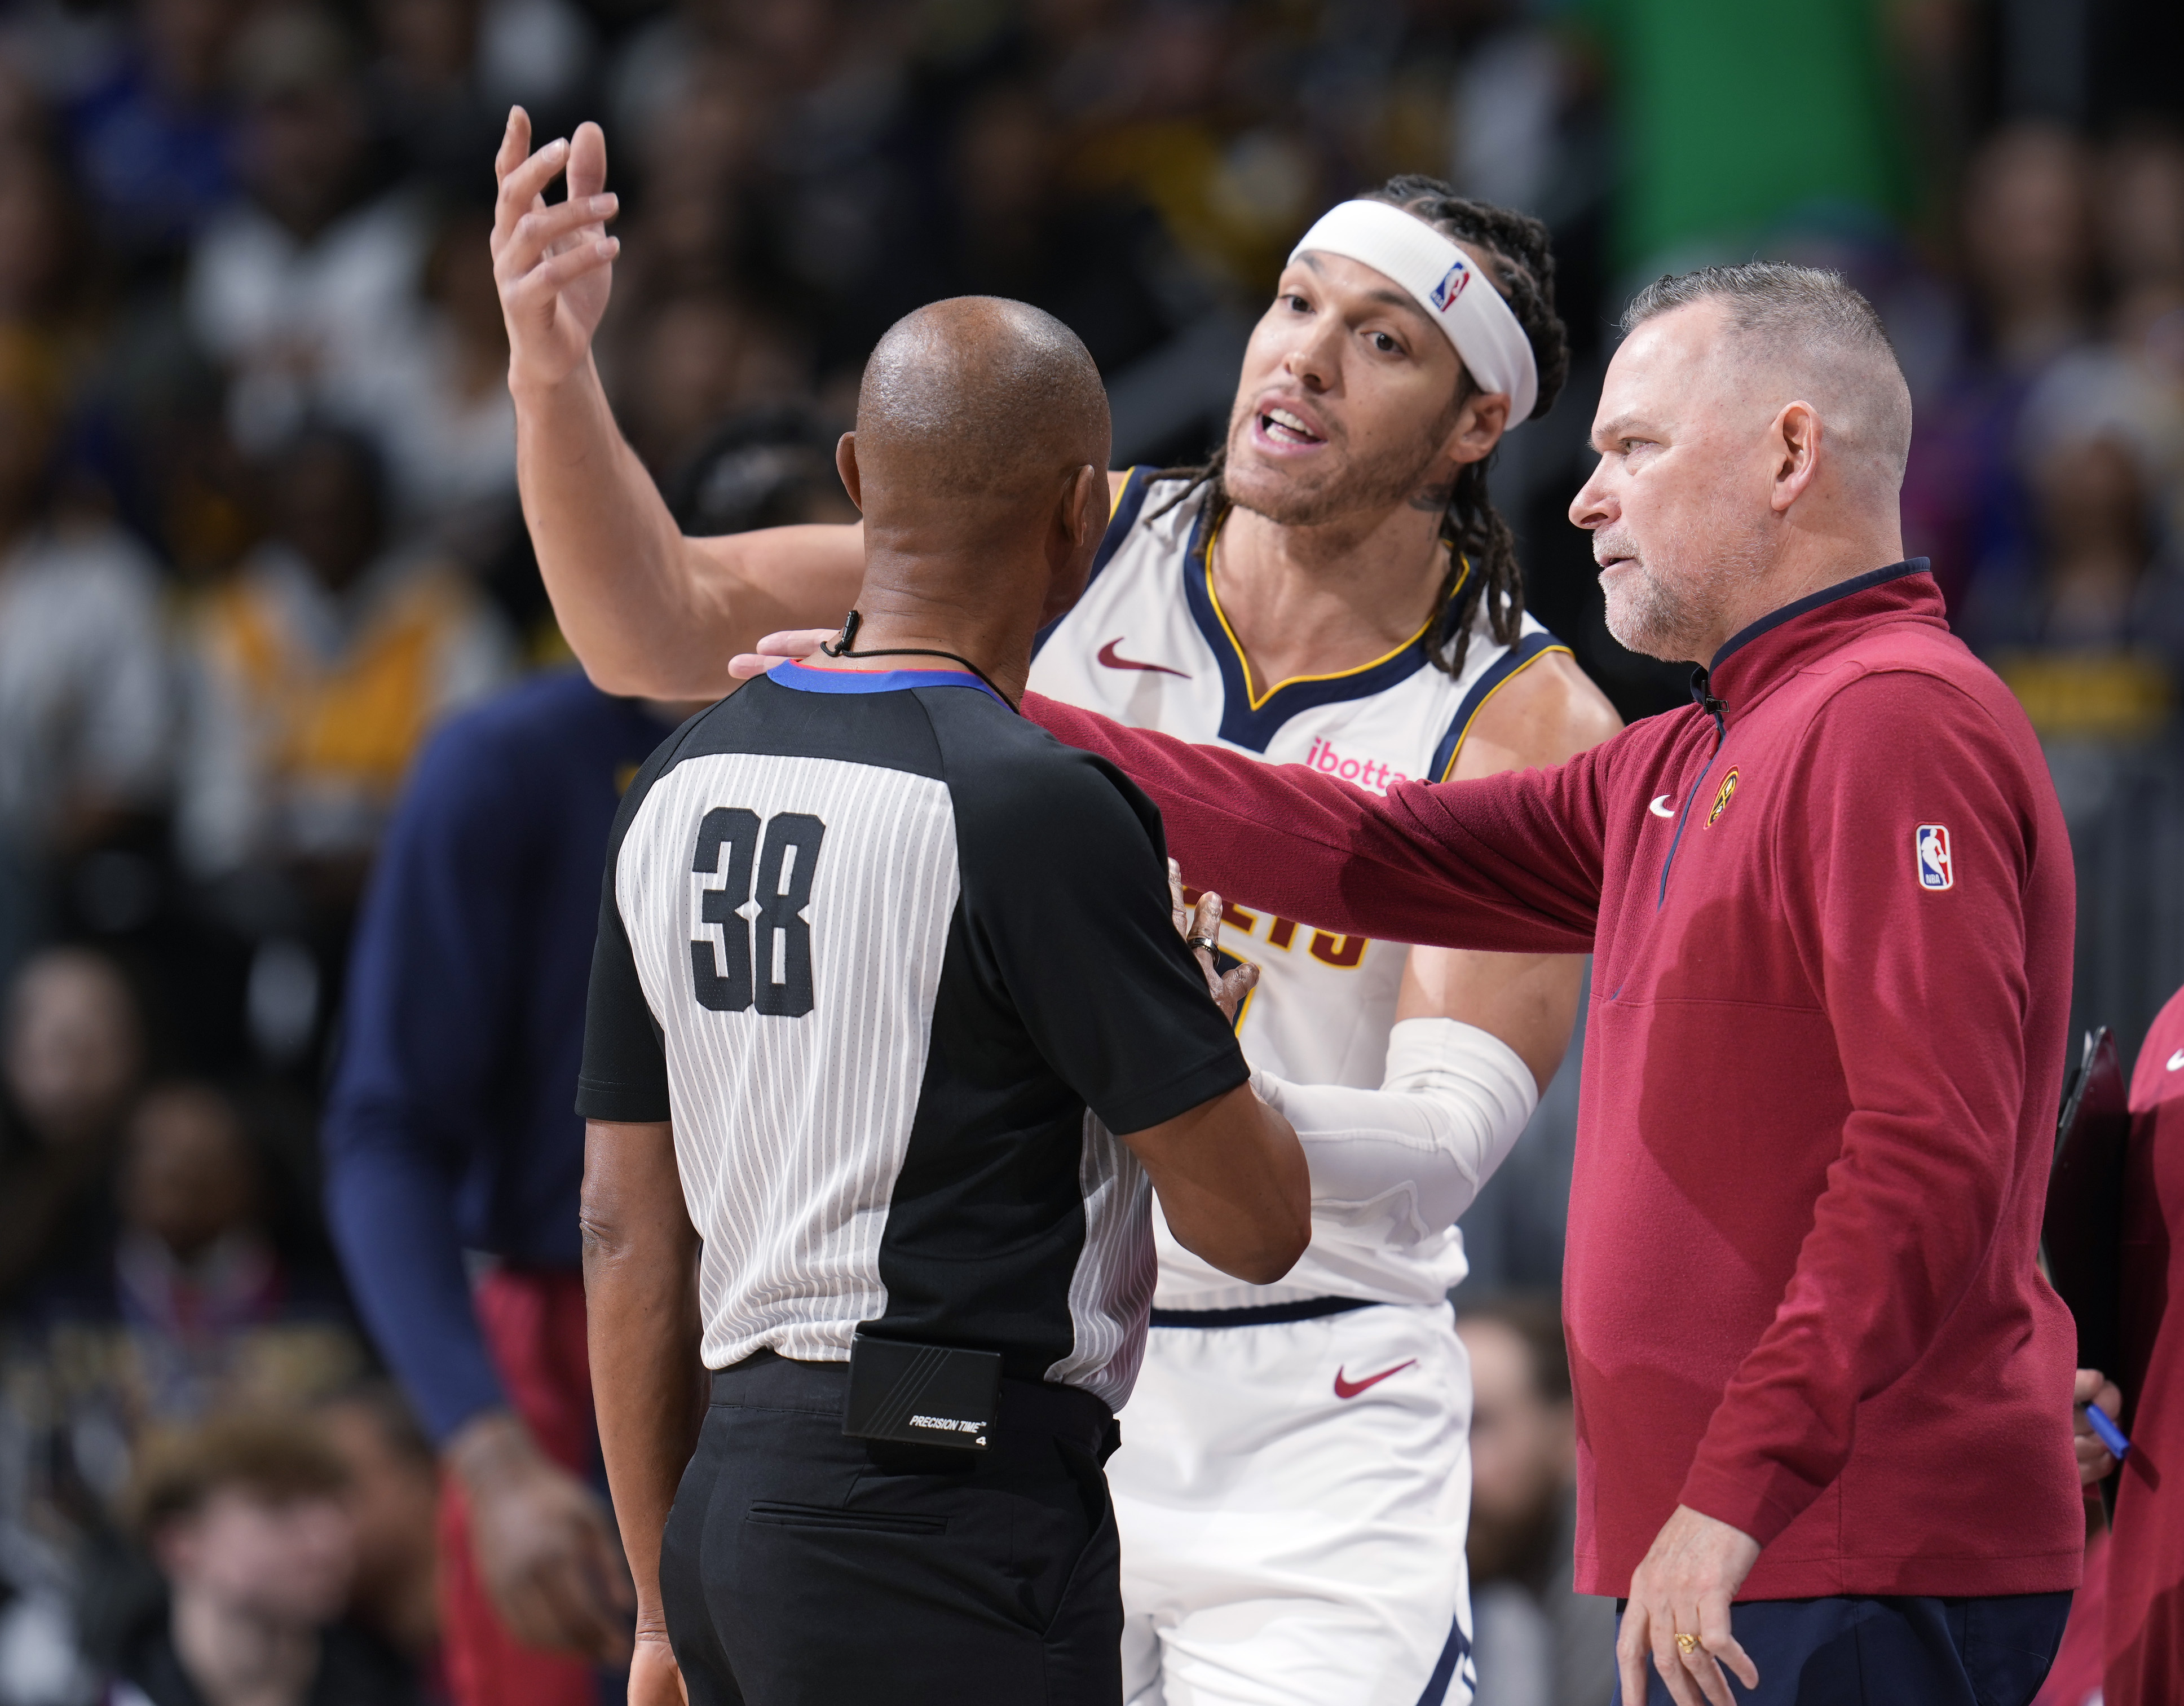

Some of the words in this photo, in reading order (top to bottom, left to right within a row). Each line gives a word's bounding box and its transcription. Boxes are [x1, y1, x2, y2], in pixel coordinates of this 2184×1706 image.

[1925, 874, 1941, 884] NBA
[691, 807, 826, 1018] 38
[909, 1415, 960, 1431] PRECISION
[976, 1436, 987, 1446] 4
